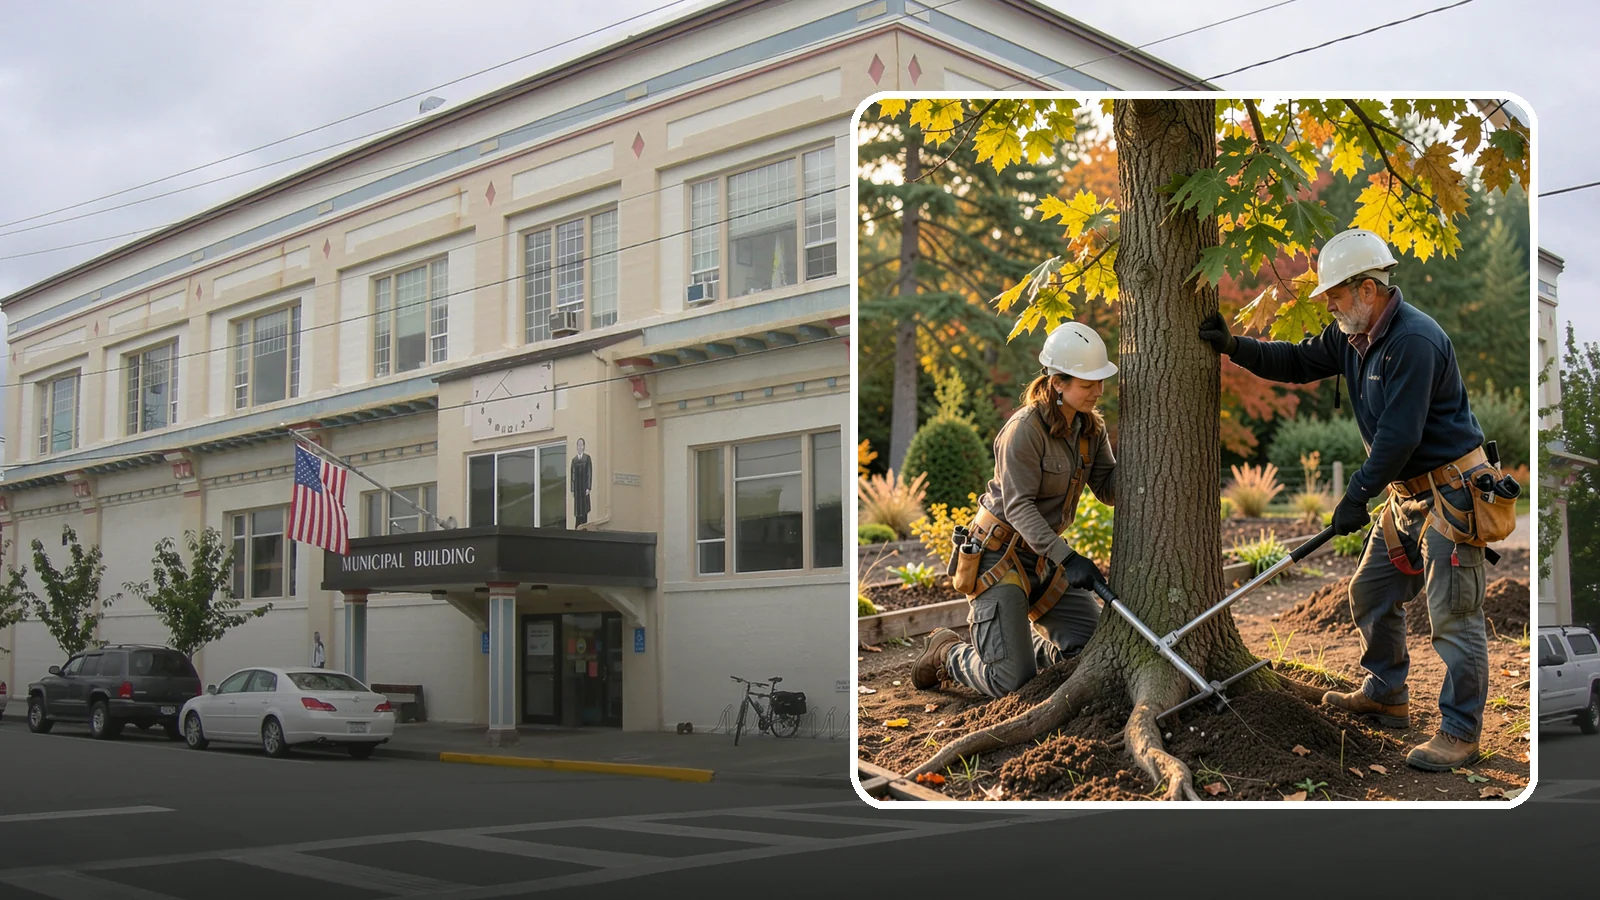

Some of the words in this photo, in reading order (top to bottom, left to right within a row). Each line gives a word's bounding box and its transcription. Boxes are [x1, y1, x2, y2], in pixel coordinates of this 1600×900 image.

[488, 418, 492, 426] 9
[342, 552, 405, 572] MUNICIPAL
[414, 546, 475, 566] BUILDING
